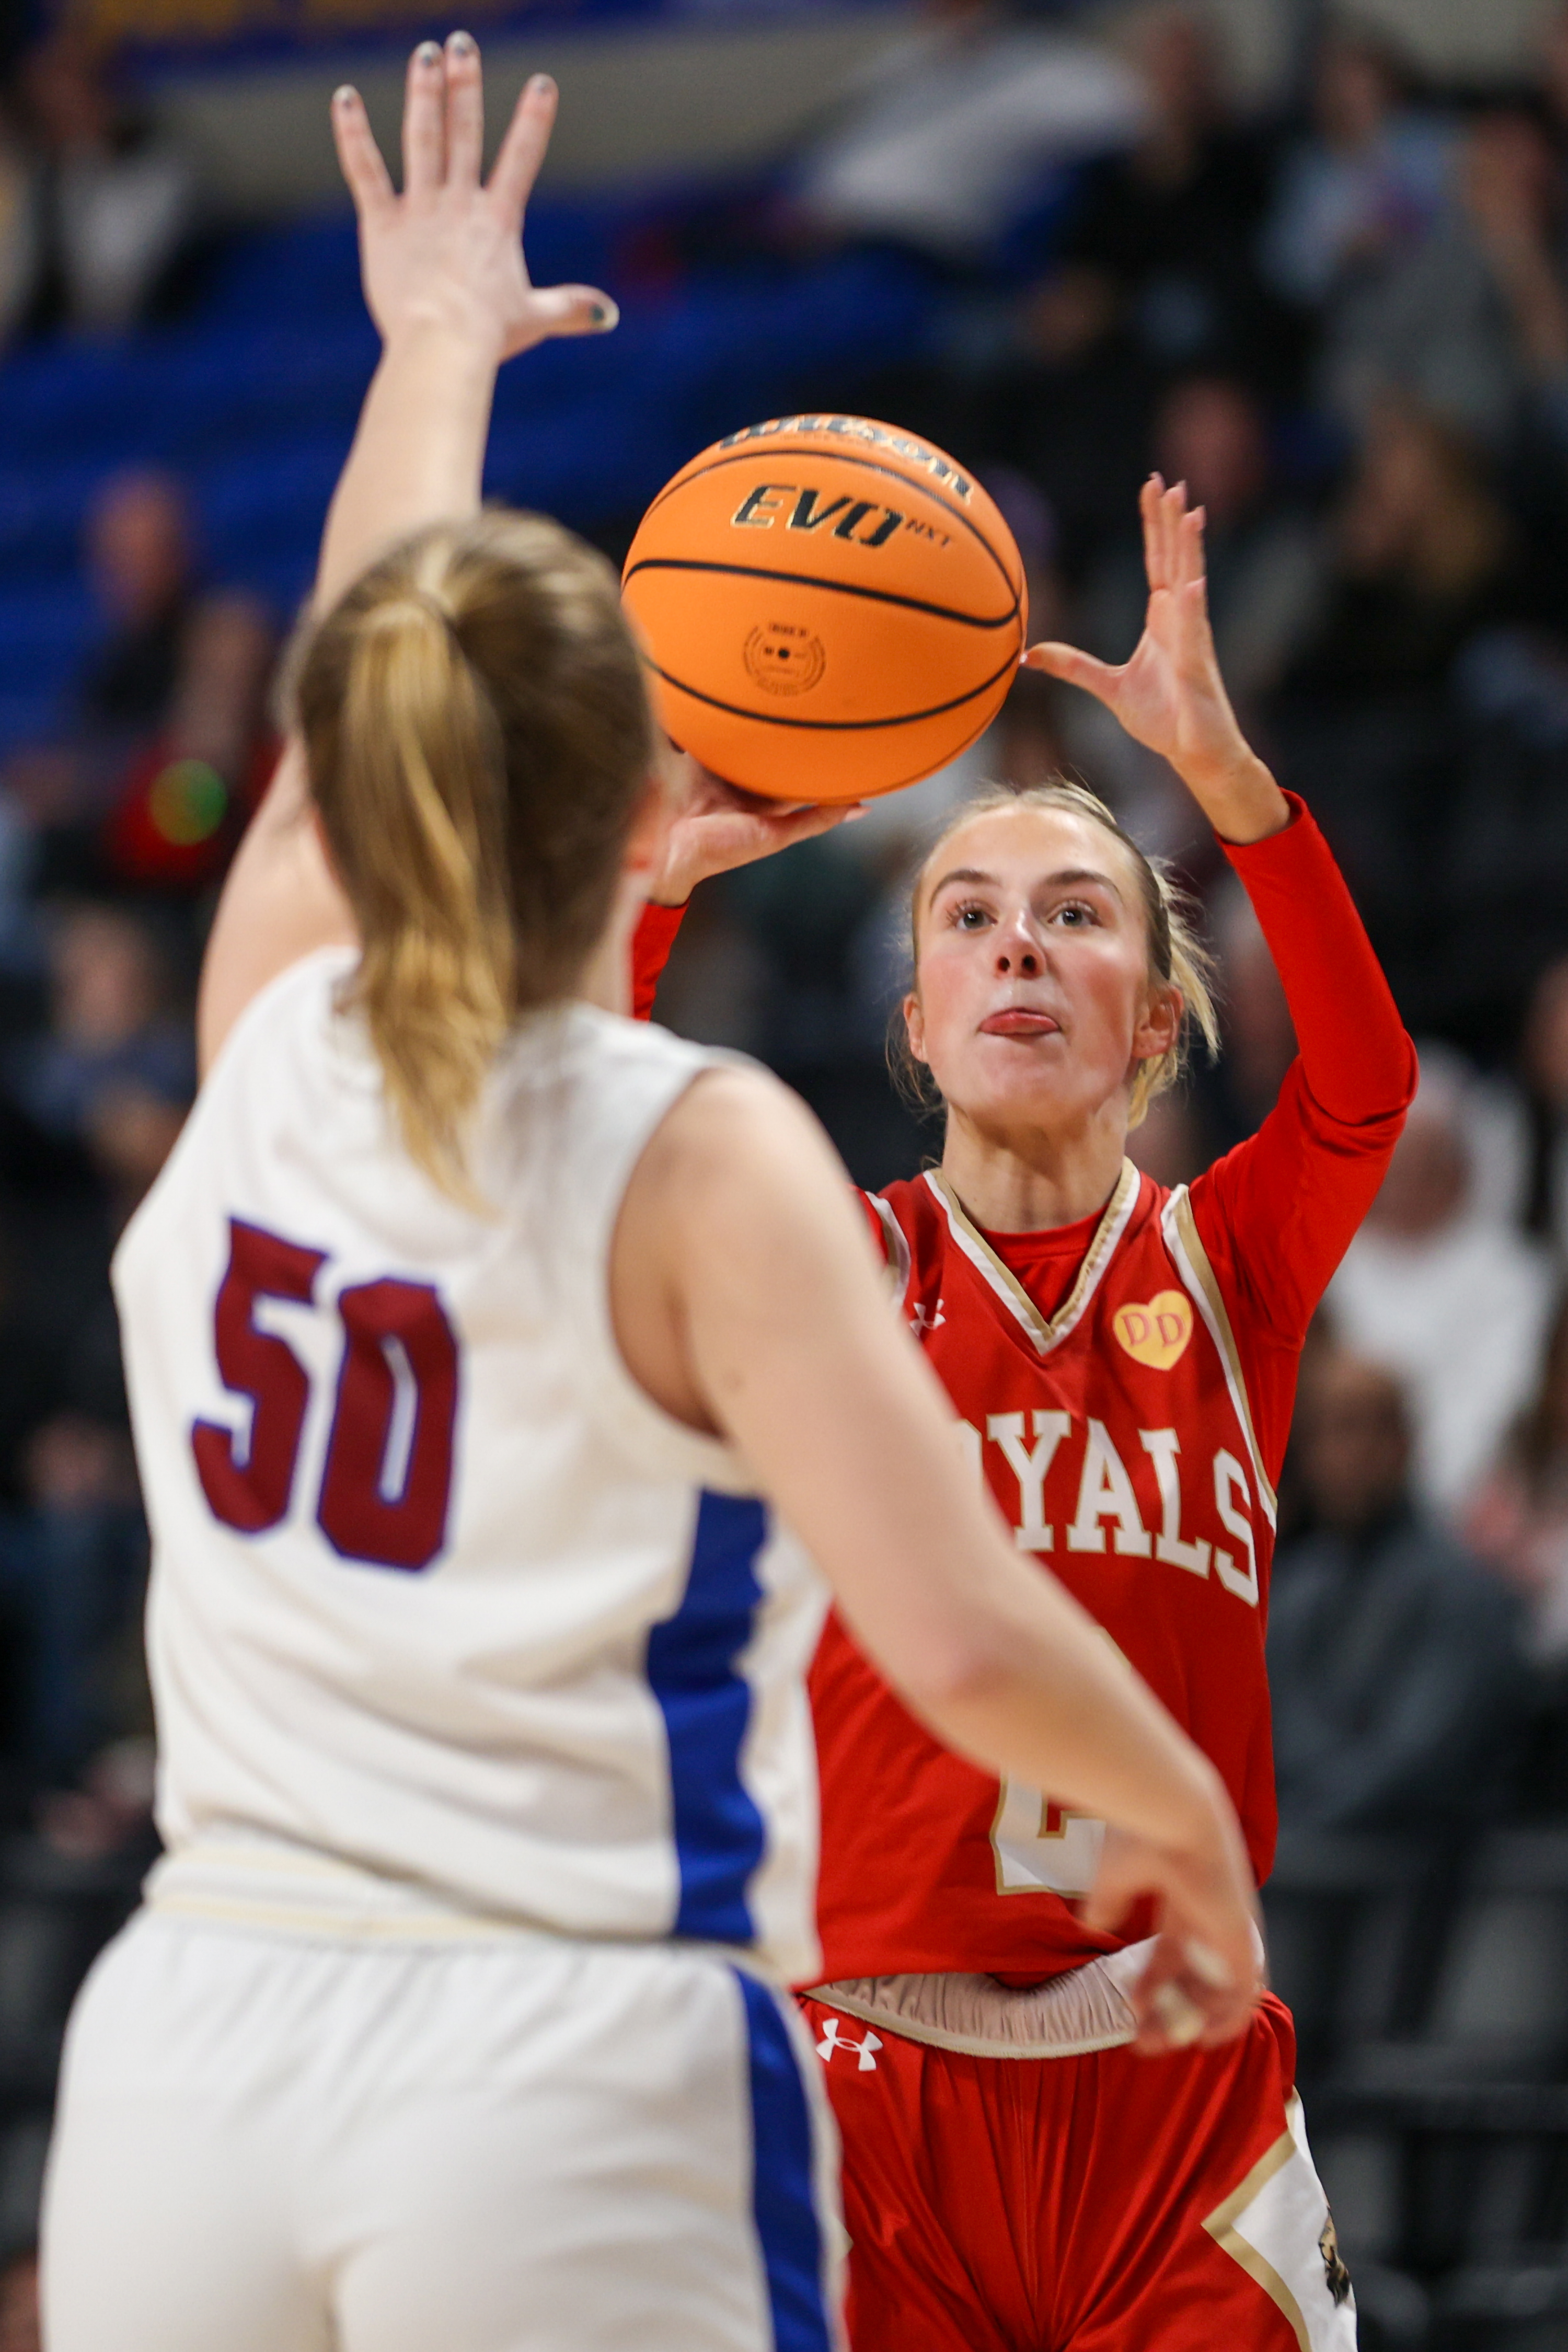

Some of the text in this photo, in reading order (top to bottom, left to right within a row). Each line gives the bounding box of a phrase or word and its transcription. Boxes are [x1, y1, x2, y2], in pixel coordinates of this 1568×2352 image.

[731, 483, 952, 549] EVO NXT
[191, 1215, 460, 1572] 50
